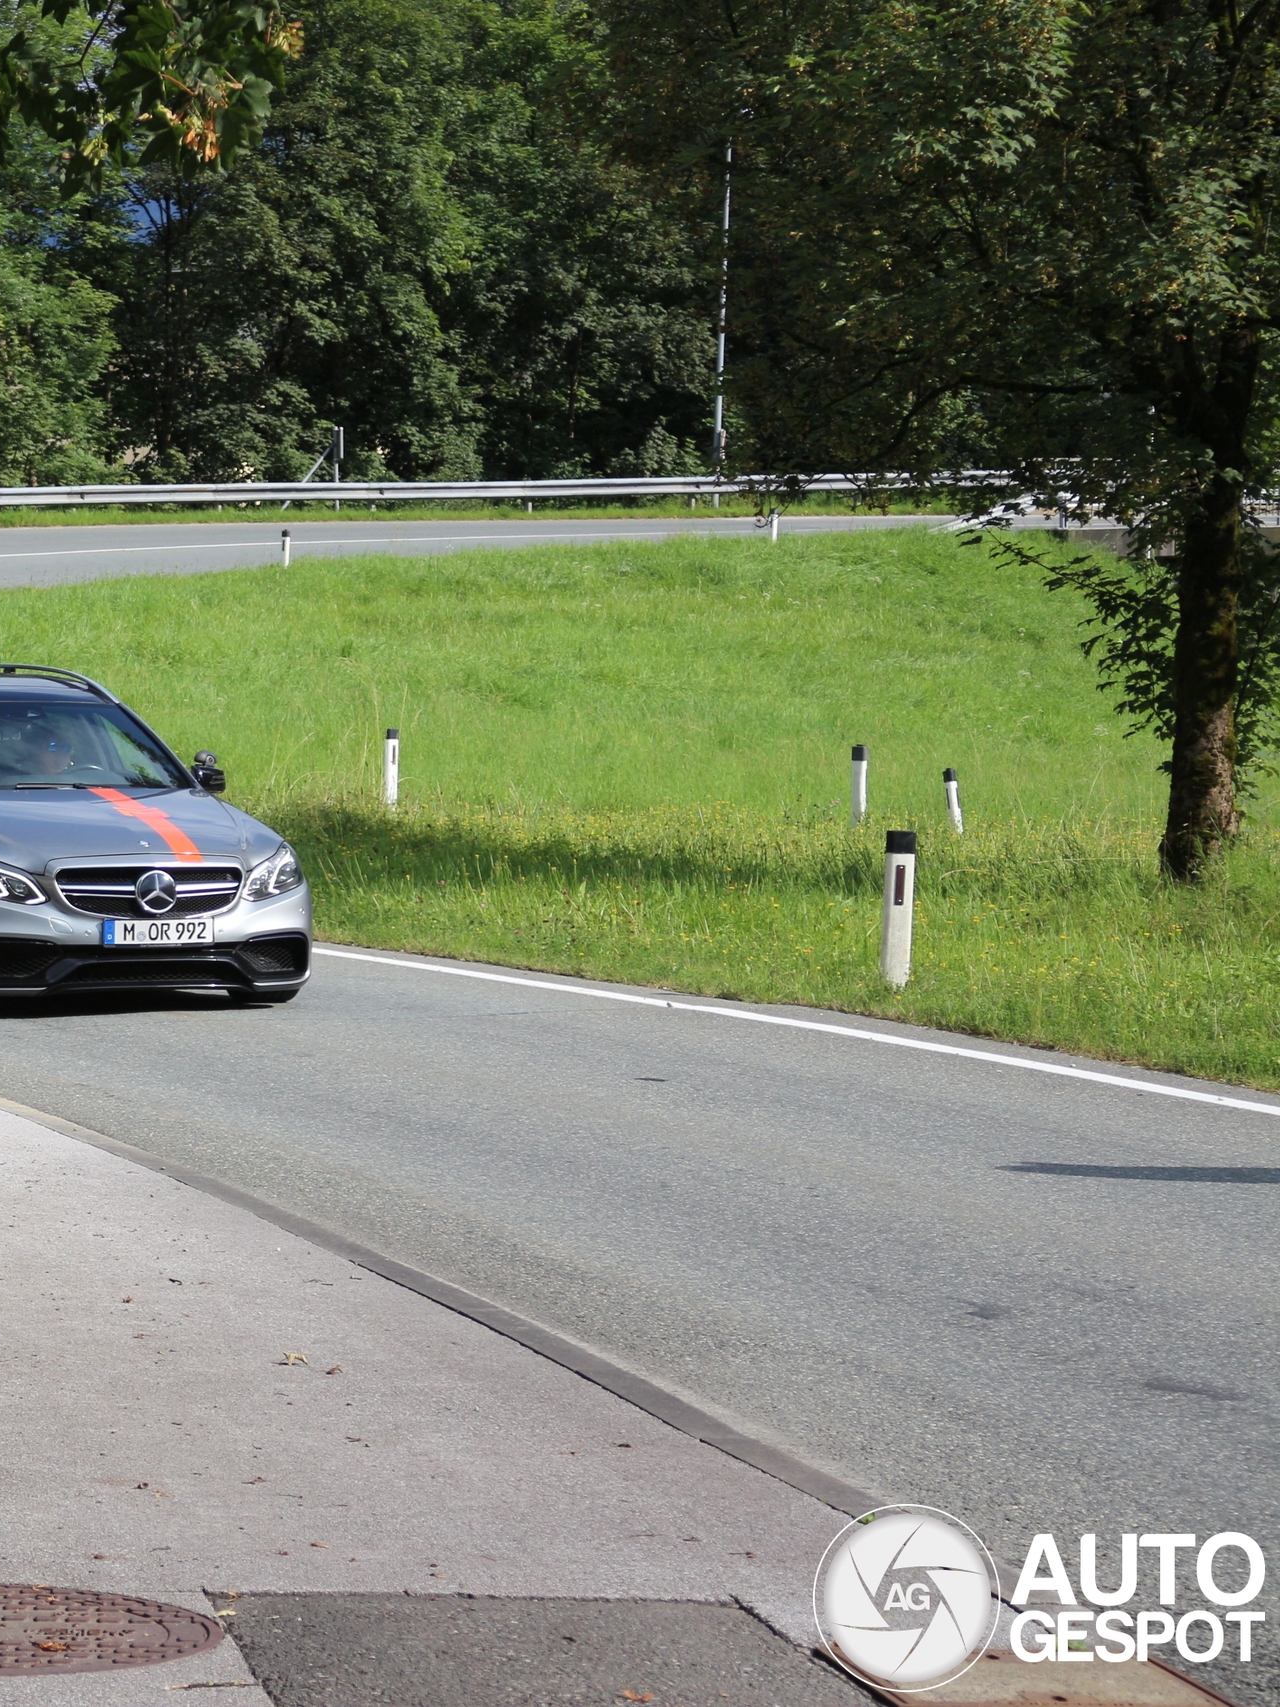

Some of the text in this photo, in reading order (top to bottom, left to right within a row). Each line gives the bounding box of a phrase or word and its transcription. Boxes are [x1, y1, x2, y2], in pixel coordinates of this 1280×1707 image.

[123, 922, 206, 941] M OR 992
